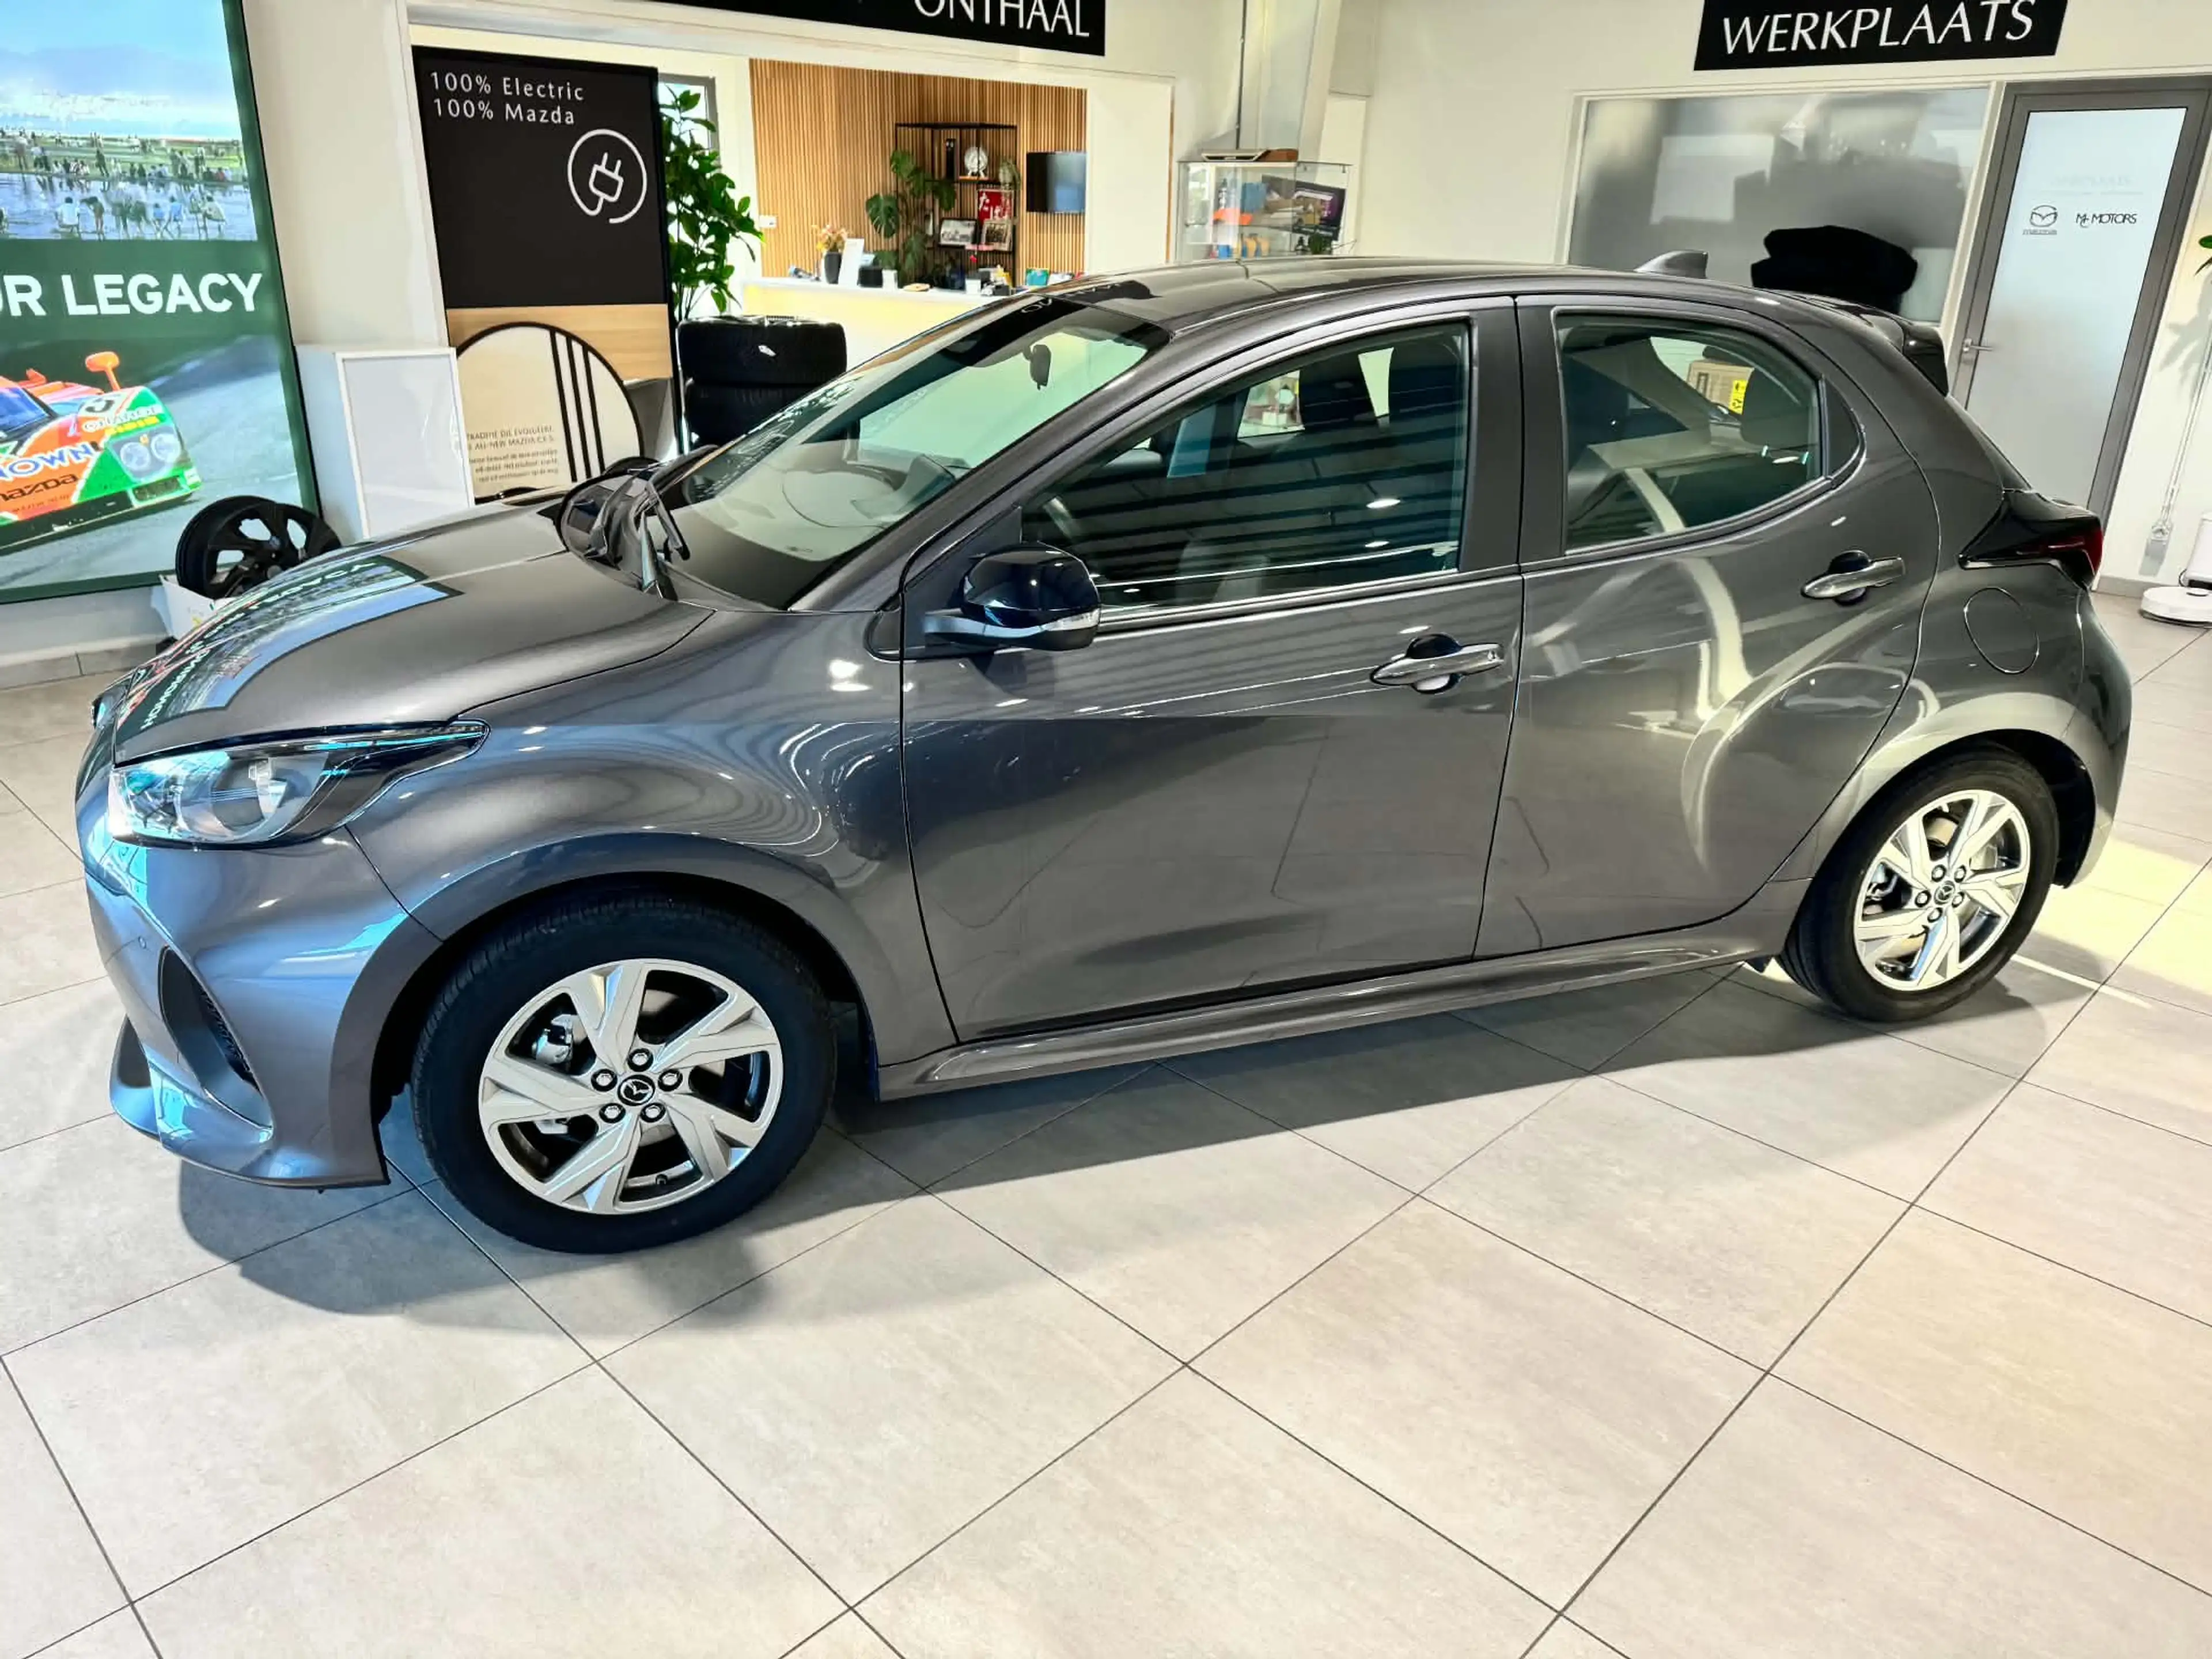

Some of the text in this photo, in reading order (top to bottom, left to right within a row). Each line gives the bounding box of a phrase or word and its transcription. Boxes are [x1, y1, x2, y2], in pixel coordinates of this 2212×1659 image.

[1722, 0, 2036, 55] WERKPLAATS
[430, 71, 584, 101] 100% Electric
[434, 98, 574, 125] 100% Mazda
[2091, 213, 2138, 224] MOTORS
[60, 272, 263, 316] LEGACY
[0, 442, 93, 481] OWN
